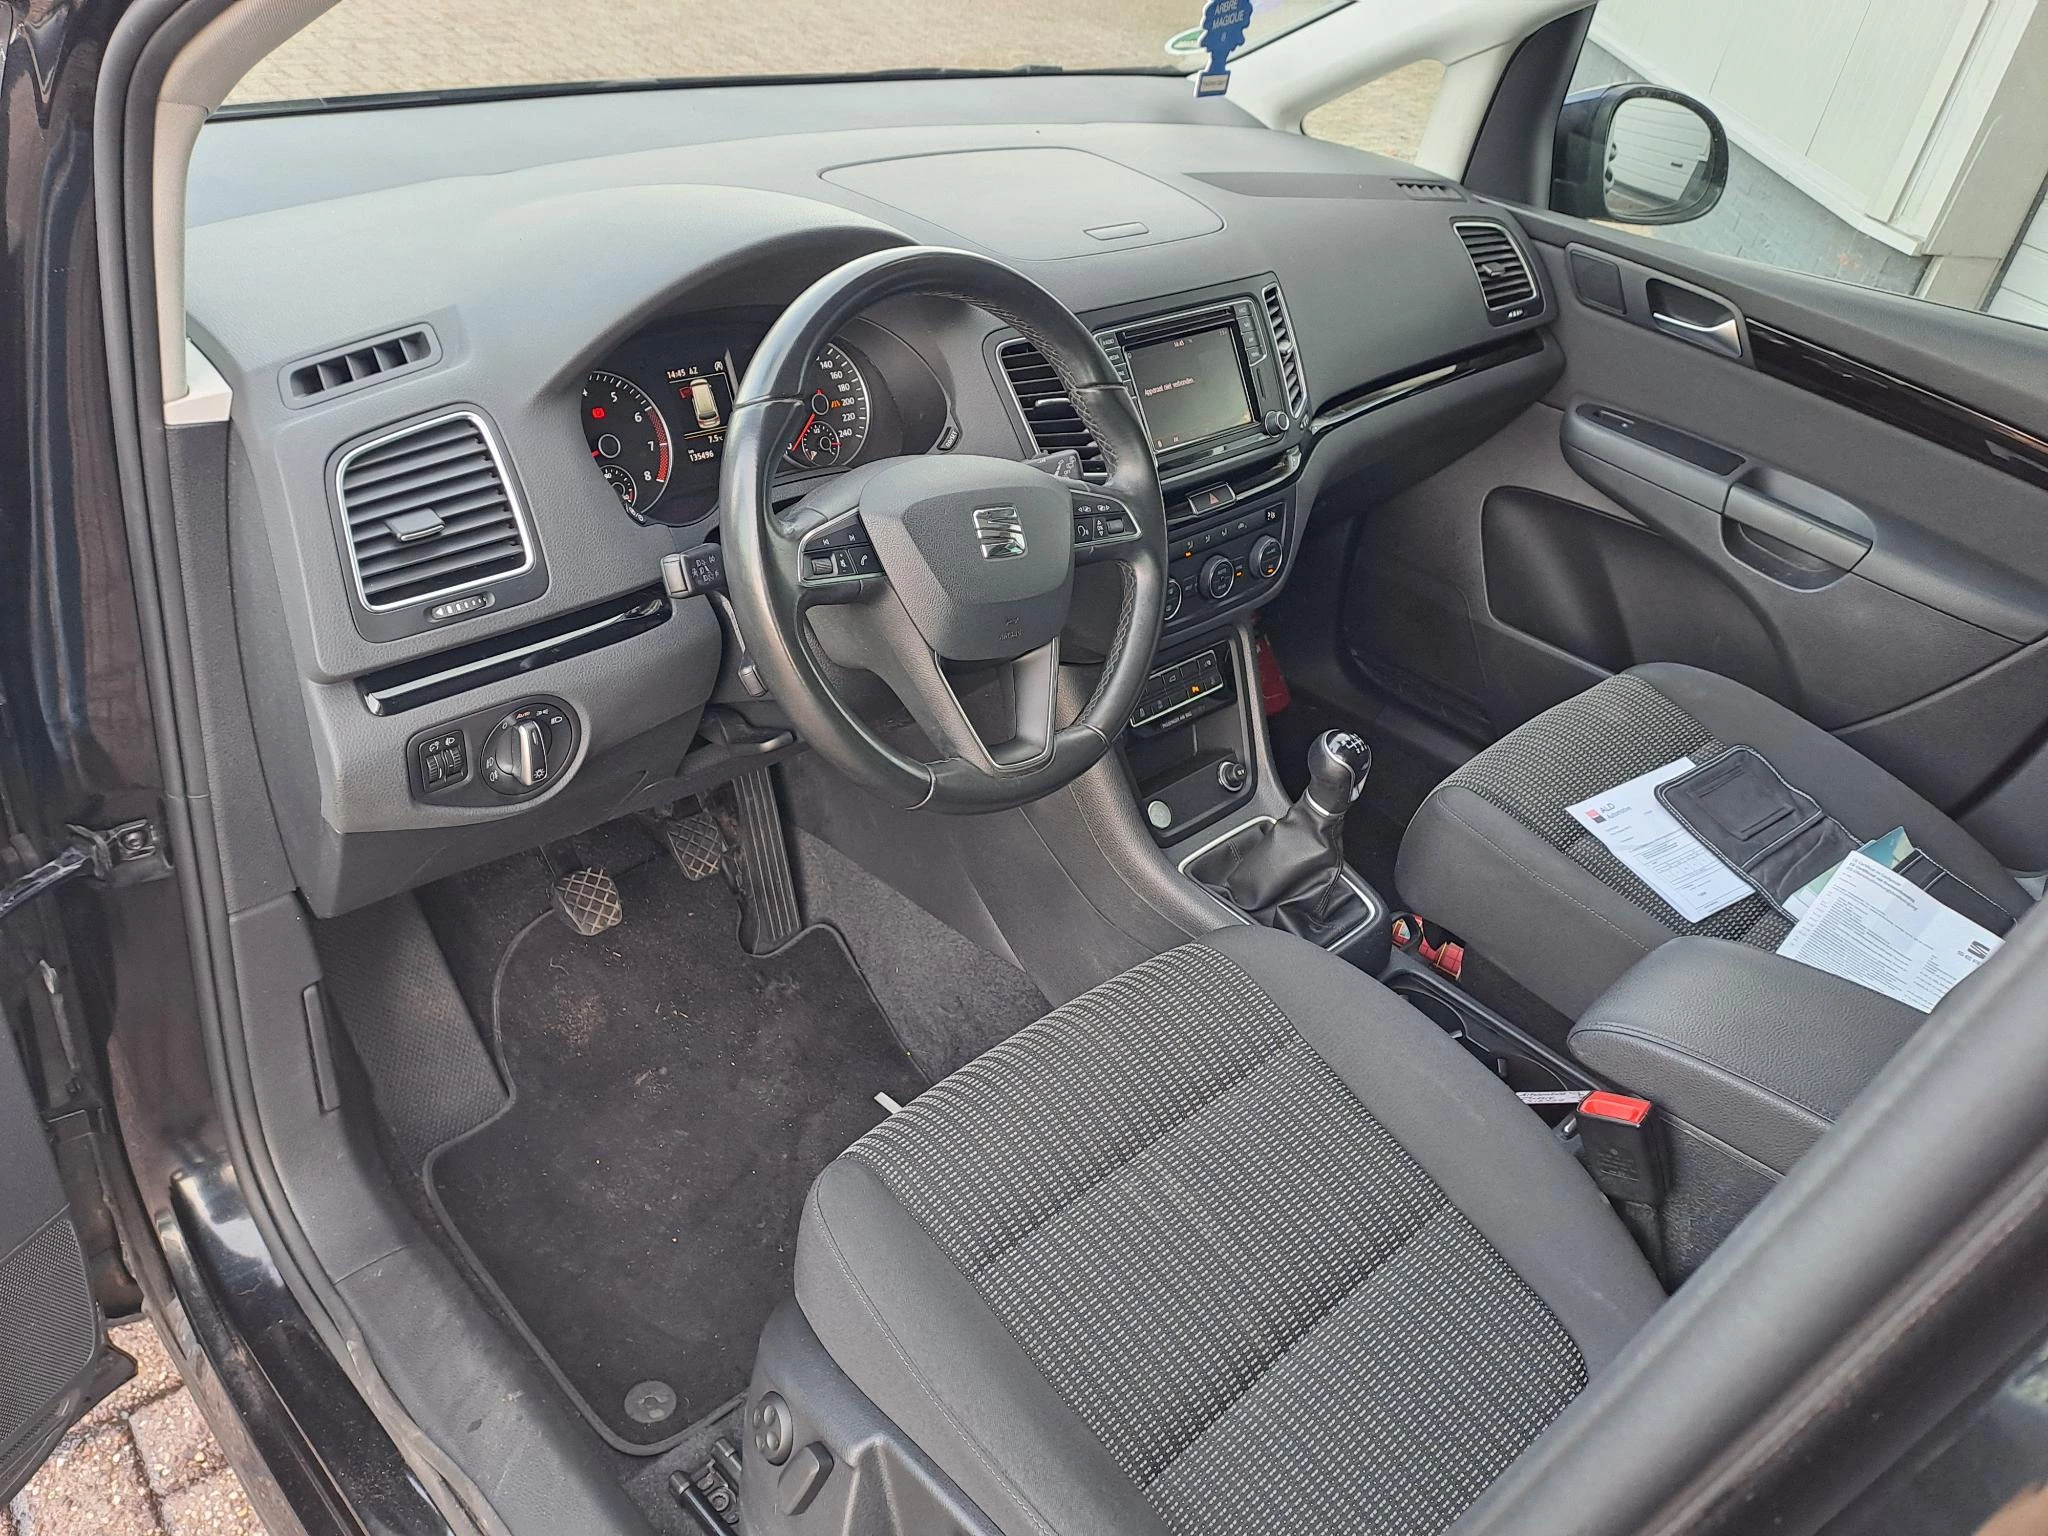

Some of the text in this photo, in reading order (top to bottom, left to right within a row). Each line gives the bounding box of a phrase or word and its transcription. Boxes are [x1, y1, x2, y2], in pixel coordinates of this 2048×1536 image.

[820, 360, 833, 369] 140
[667, 368, 686, 379] 14:45
[830, 370, 843, 380] 160
[838, 383, 850, 392] 180
[610, 392, 618, 402] 5
[841, 398, 855, 406] 200
[634, 412, 642, 422] 6
[842, 412, 856, 422] 220
[838, 429, 852, 437] 240
[647, 440, 654, 452] 7
[690, 450, 714, 462] 135496
[643, 470, 652, 481] 8
